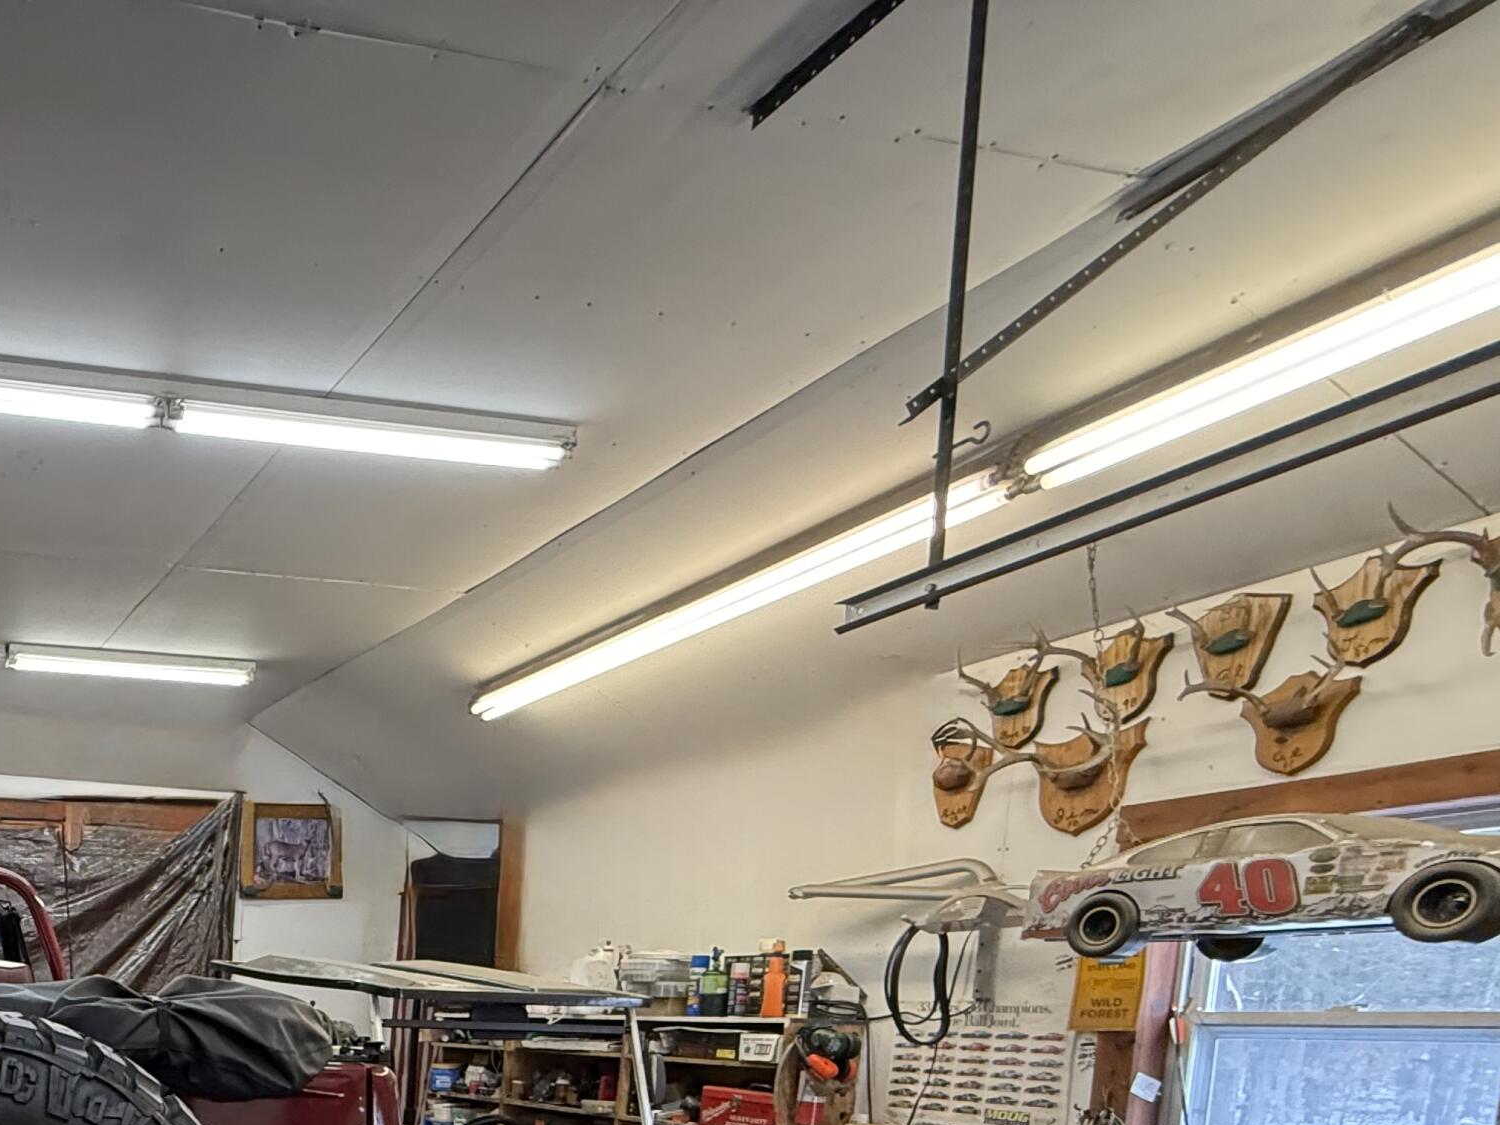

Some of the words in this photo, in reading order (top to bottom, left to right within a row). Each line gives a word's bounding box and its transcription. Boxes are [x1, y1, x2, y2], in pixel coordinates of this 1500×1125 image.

[1112, 865, 1186, 884] LIGHT
[1197, 858, 1299, 916] 40
[1091, 998, 1123, 1008] WILD
[1080, 1008, 1129, 1019] FOREST
[986, 1110, 1029, 1123] MOOG
